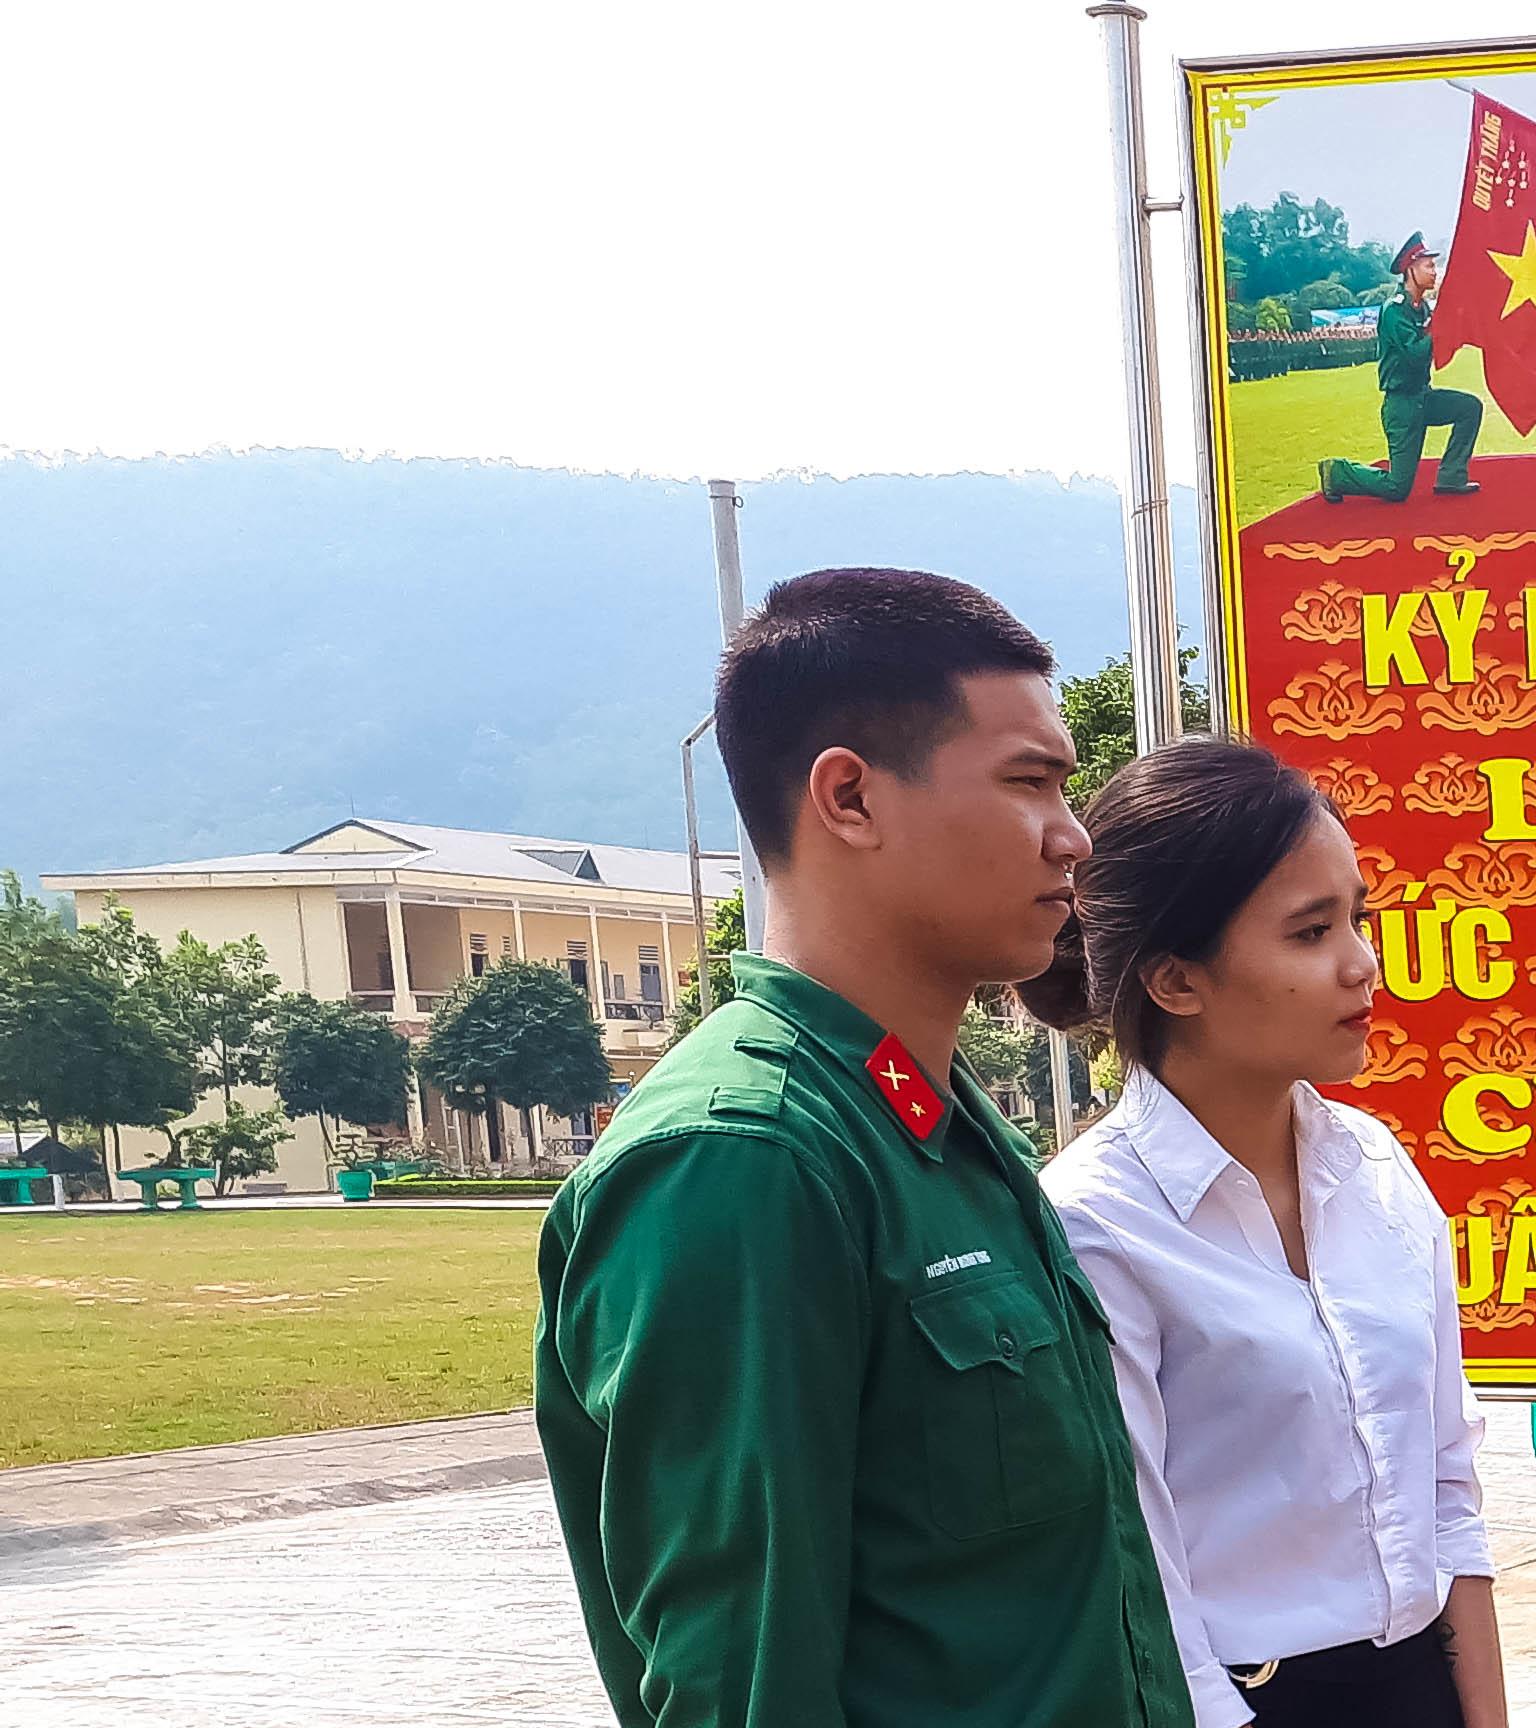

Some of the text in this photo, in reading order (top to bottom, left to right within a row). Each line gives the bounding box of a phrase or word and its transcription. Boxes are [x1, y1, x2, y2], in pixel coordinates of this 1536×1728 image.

[1472, 160, 1496, 211] QUYẾT
[1363, 550, 1490, 687] KỶ
[1361, 882, 1516, 1001] ỨC
